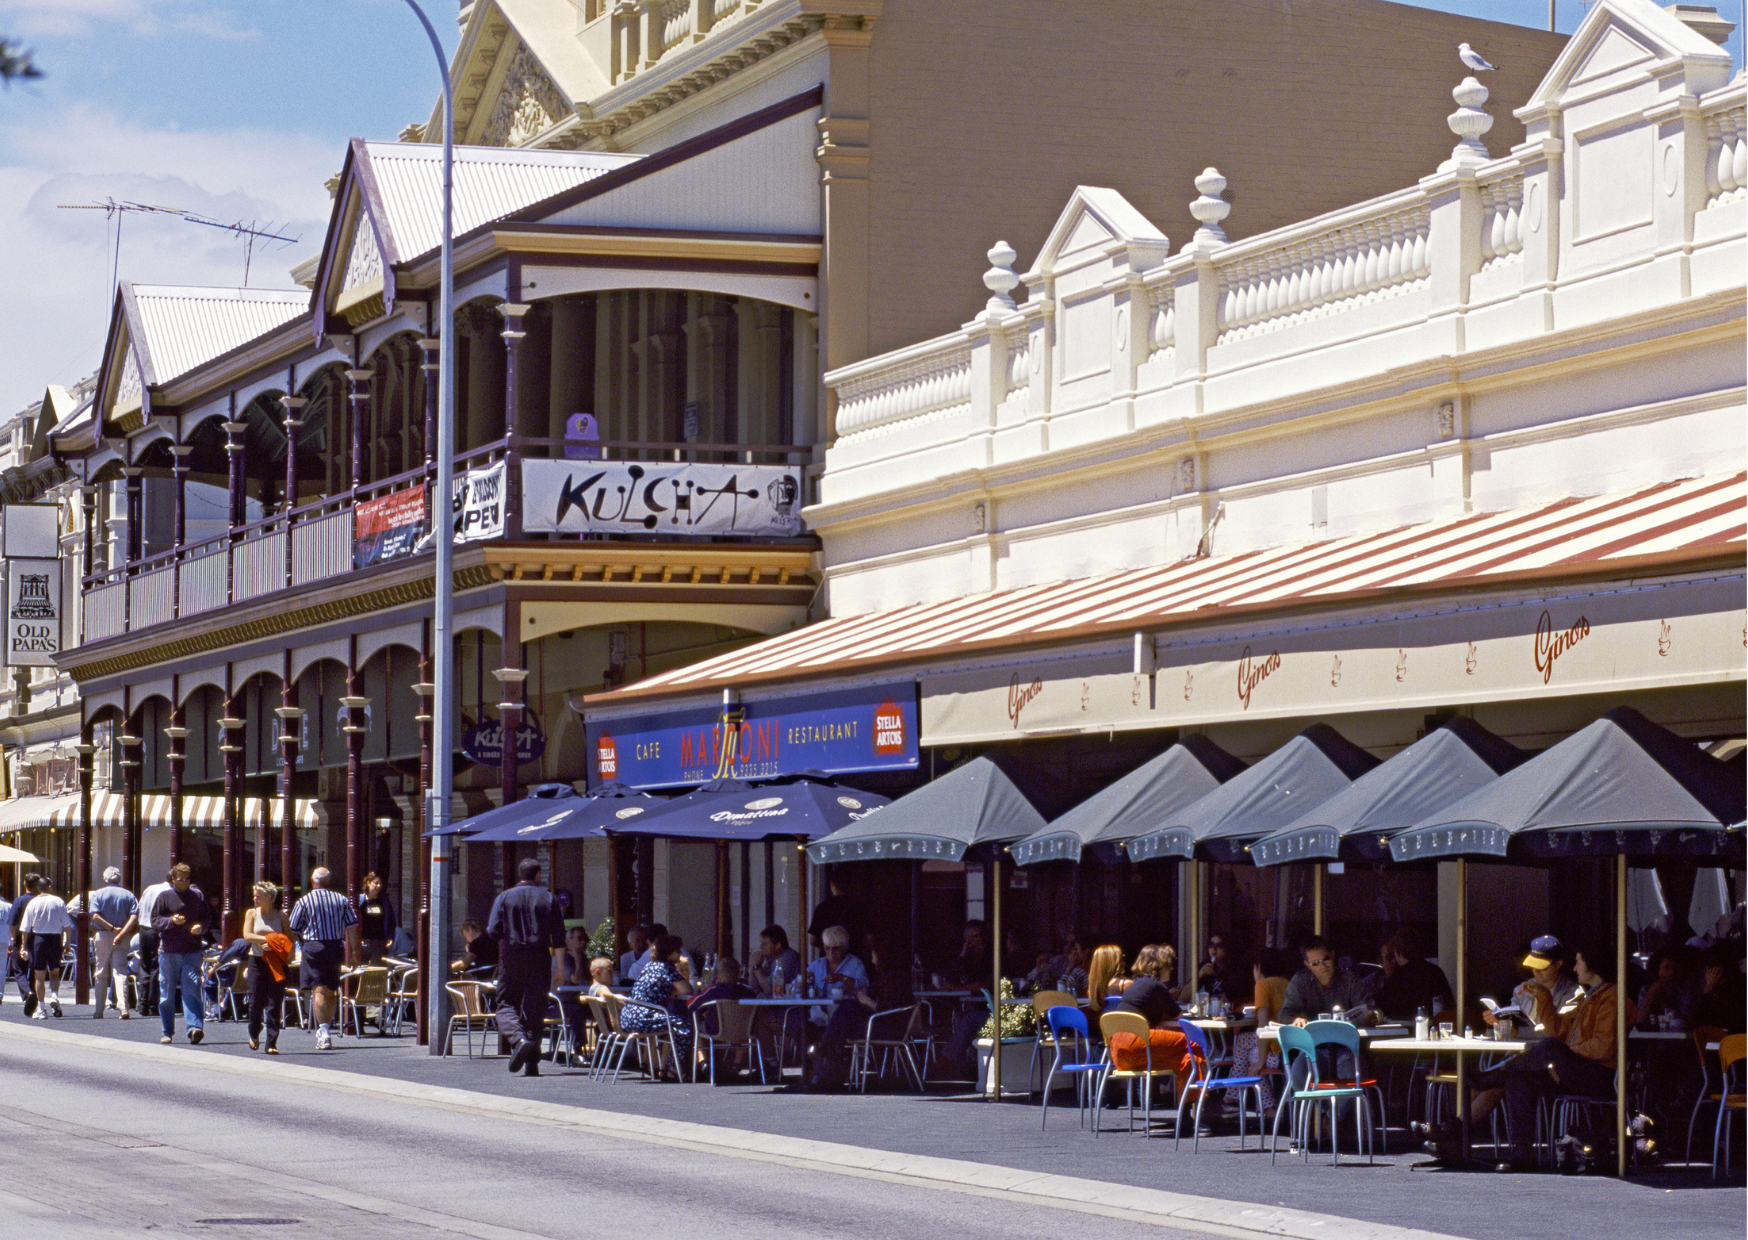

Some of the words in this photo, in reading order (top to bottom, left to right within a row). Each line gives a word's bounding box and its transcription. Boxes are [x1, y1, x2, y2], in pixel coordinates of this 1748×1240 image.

[557, 465, 759, 530] KULCHA
[17, 623, 50, 638] OLD
[12, 637, 57, 652] PAPA'S
[876, 715, 902, 730] STELLA
[788, 721, 857, 744] RESTAURANT
[876, 731, 902, 746] ARTOIS
[636, 742, 660, 761] CAFE
[684, 770, 704, 782] PHONE
